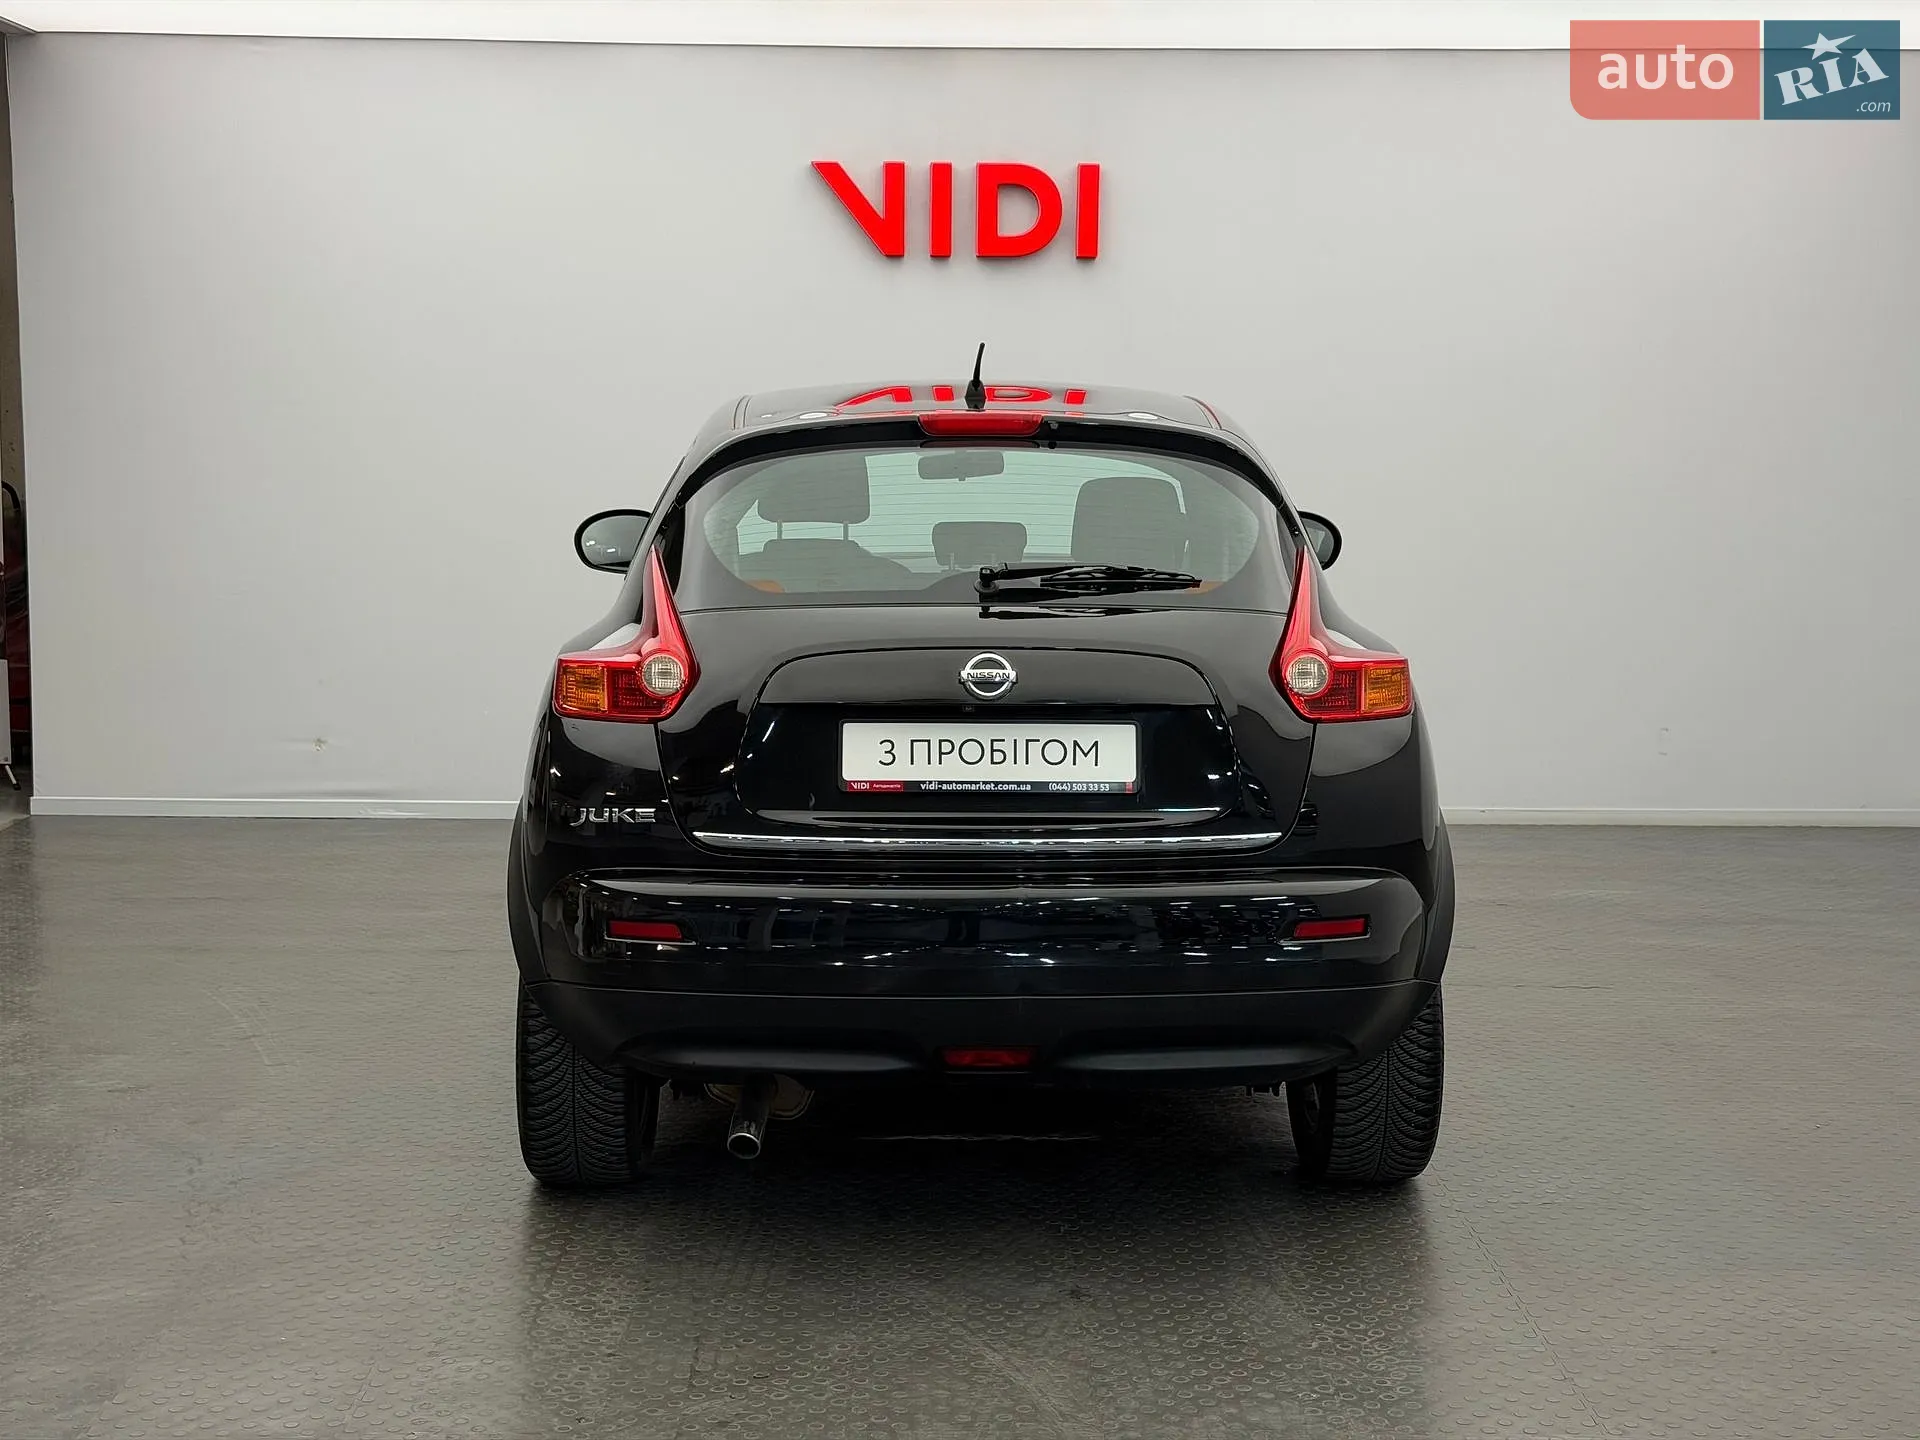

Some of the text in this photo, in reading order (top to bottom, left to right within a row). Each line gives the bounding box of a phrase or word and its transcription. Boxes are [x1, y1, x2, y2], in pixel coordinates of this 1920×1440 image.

[810, 160, 1101, 259] VIDI
[966, 671, 1010, 679] NISSAN
[909, 738, 1100, 767] ПРОБІГОМ
[850, 781, 870, 790] VIDI
[919, 781, 1032, 791] vidi-automarket.com.ua
[1048, 782, 1110, 792] (044) 503 33 53
[569, 807, 657, 828] JUKE
